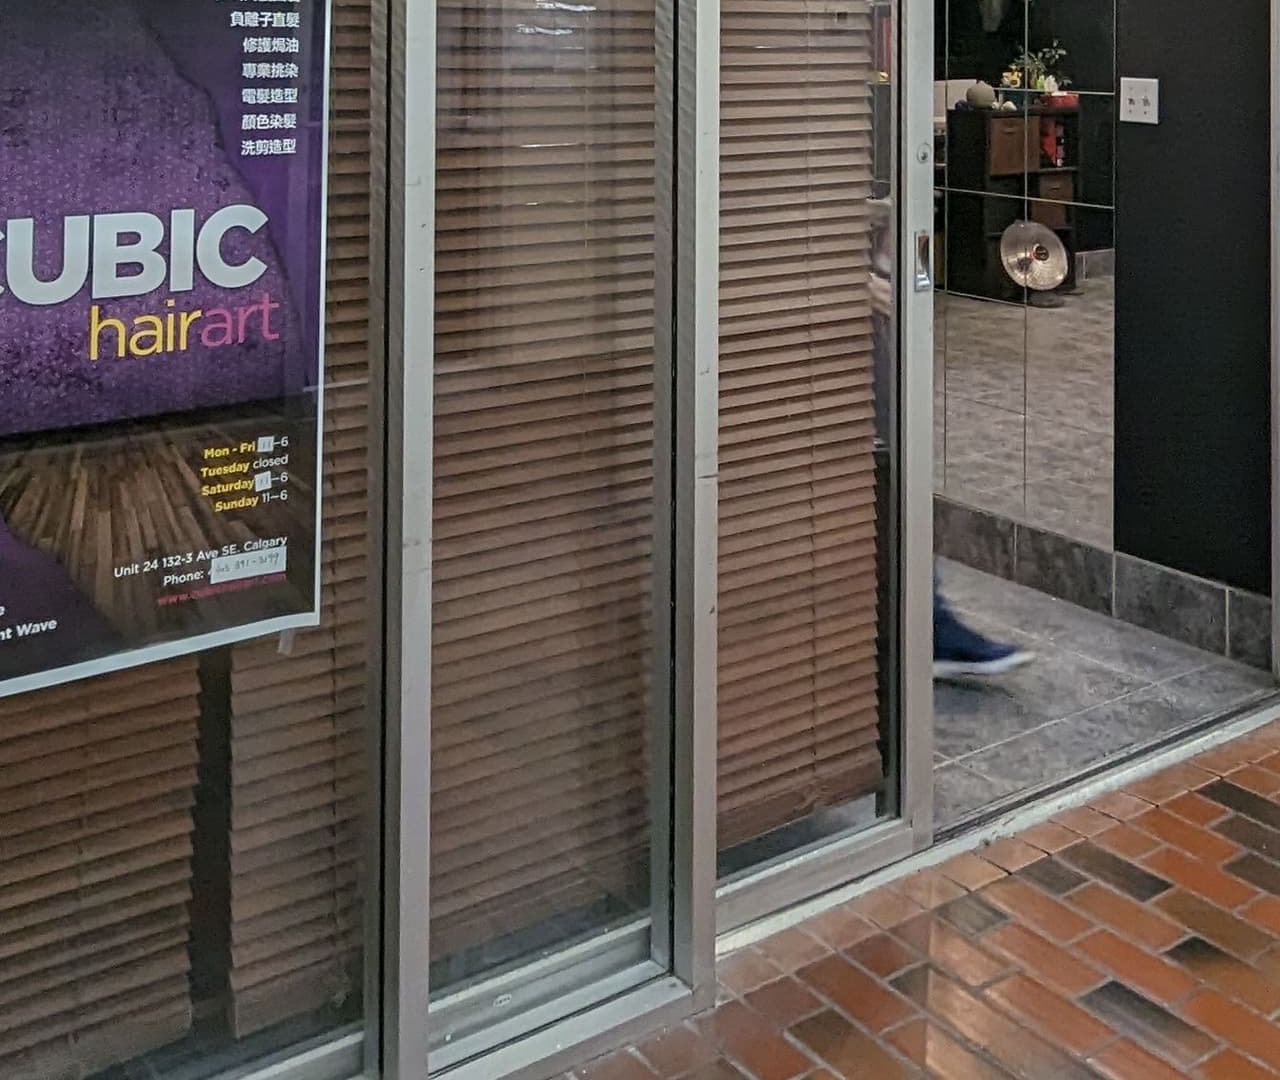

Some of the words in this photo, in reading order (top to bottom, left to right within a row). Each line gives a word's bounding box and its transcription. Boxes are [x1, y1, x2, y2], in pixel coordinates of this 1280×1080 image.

[203, 445, 230, 459] Mon
[240, 440, 256, 453] Fri
[200, 462, 250, 478] Tuesday
[252, 454, 289, 469] closed
[202, 480, 254, 496] Saturday
[215, 496, 259, 512] Sunday
[113, 563, 139, 578] Unit
[143, 560, 159, 572] 24
[162, 552, 193, 568] 132-3
[196, 549, 219, 562] Ave
[244, 536, 288, 553] Calgary
[163, 570, 205, 587] Phone:
[16, 619, 58, 637] Wave
